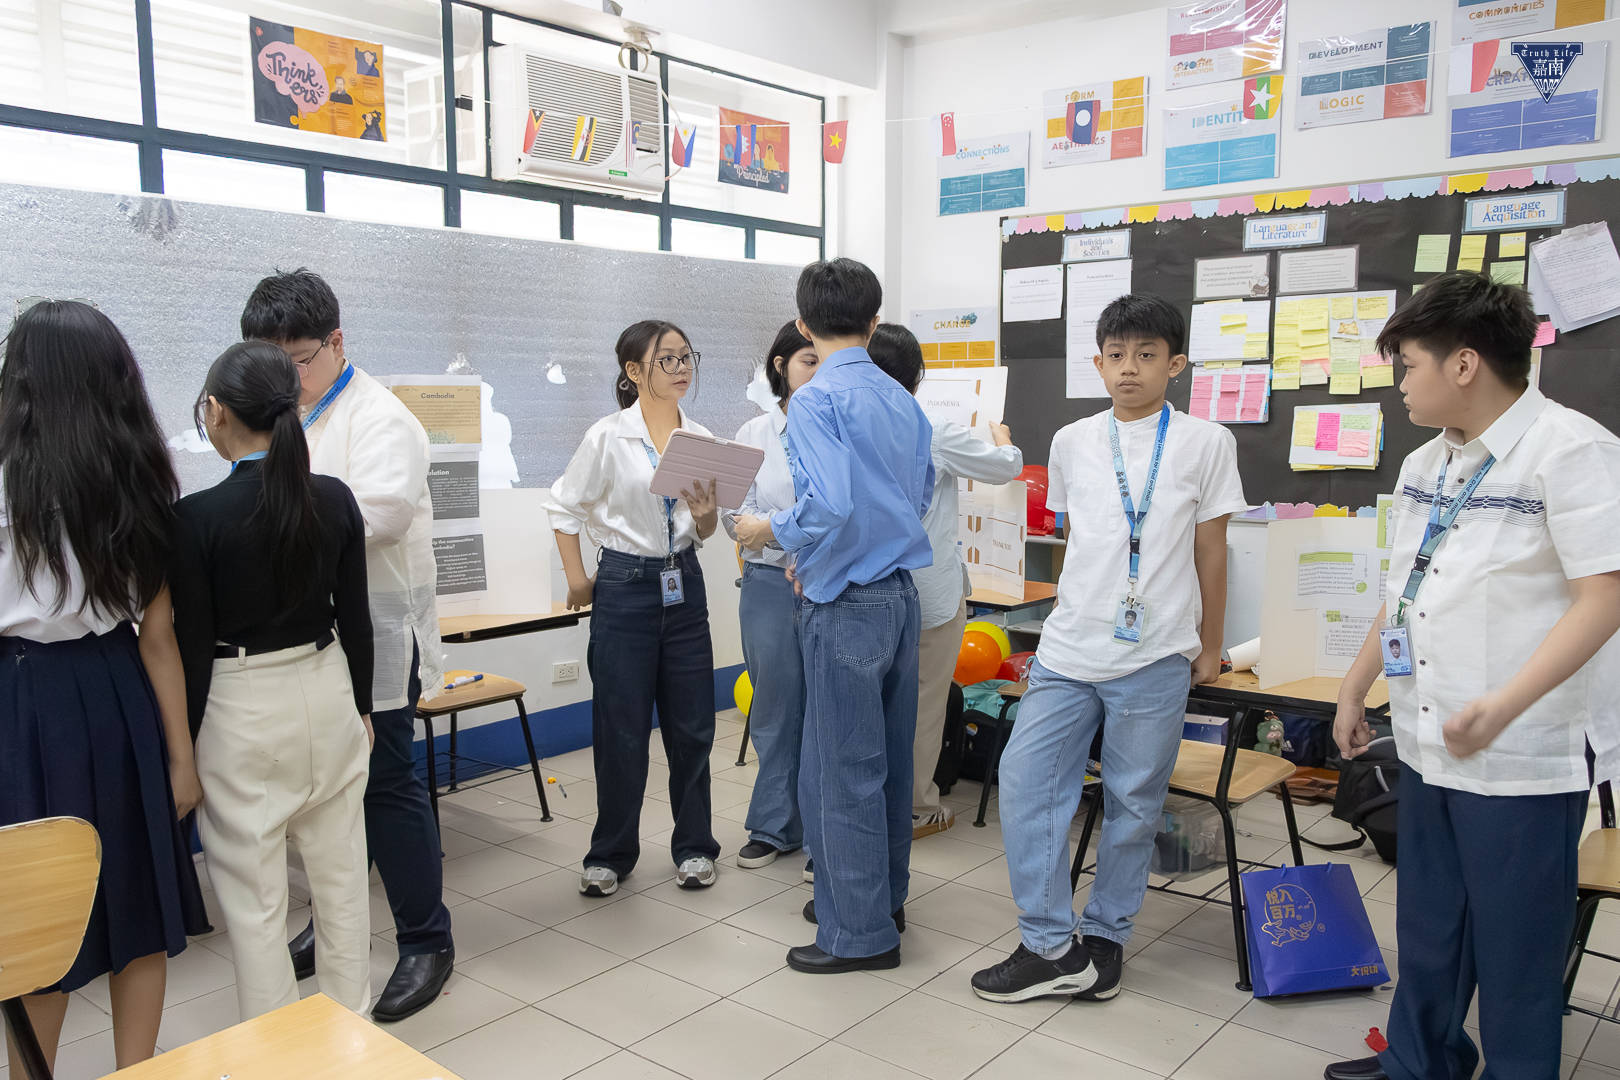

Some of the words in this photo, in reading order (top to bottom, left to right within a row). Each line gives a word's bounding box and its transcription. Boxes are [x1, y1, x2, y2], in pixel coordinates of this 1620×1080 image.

[1180, 3, 1236, 19] REATIONSHIS
[1468, 1, 1545, 20] COMMUNITIES
[1308, 41, 1384, 60] DEVELOPMENT
[265, 51, 318, 88] Think
[1173, 67, 1214, 78] INTERACTION
[1486, 71, 1532, 87] CREAT
[1065, 90, 1096, 102] FORM
[1318, 94, 1365, 111] LOGIC
[1191, 109, 1244, 129] IDENTIT
[1051, 136, 1106, 151] AESTHCS
[955, 145, 1010, 160] CONNECTIONS
[736, 165, 771, 186] Principled
[1486, 200, 1541, 214] Language
[1482, 209, 1546, 224] Acquisition
[1253, 222, 1298, 234] Language
[1299, 219, 1318, 230] and
[1079, 237, 1114, 247] Individuals
[1261, 229, 1307, 240] Literature
[1082, 249, 1110, 258] Societies
[934, 319, 971, 330] CHANGE
[927, 400, 960, 408] INDONESIA
[1467, 479, 1477, 493] God
[1457, 491, 1467, 504] and
[1448, 503, 1459, 516] man
[992, 539, 1004, 549] THANK
[1004, 543, 1012, 552] YOU
[1269, 904, 1296, 920] 百万
